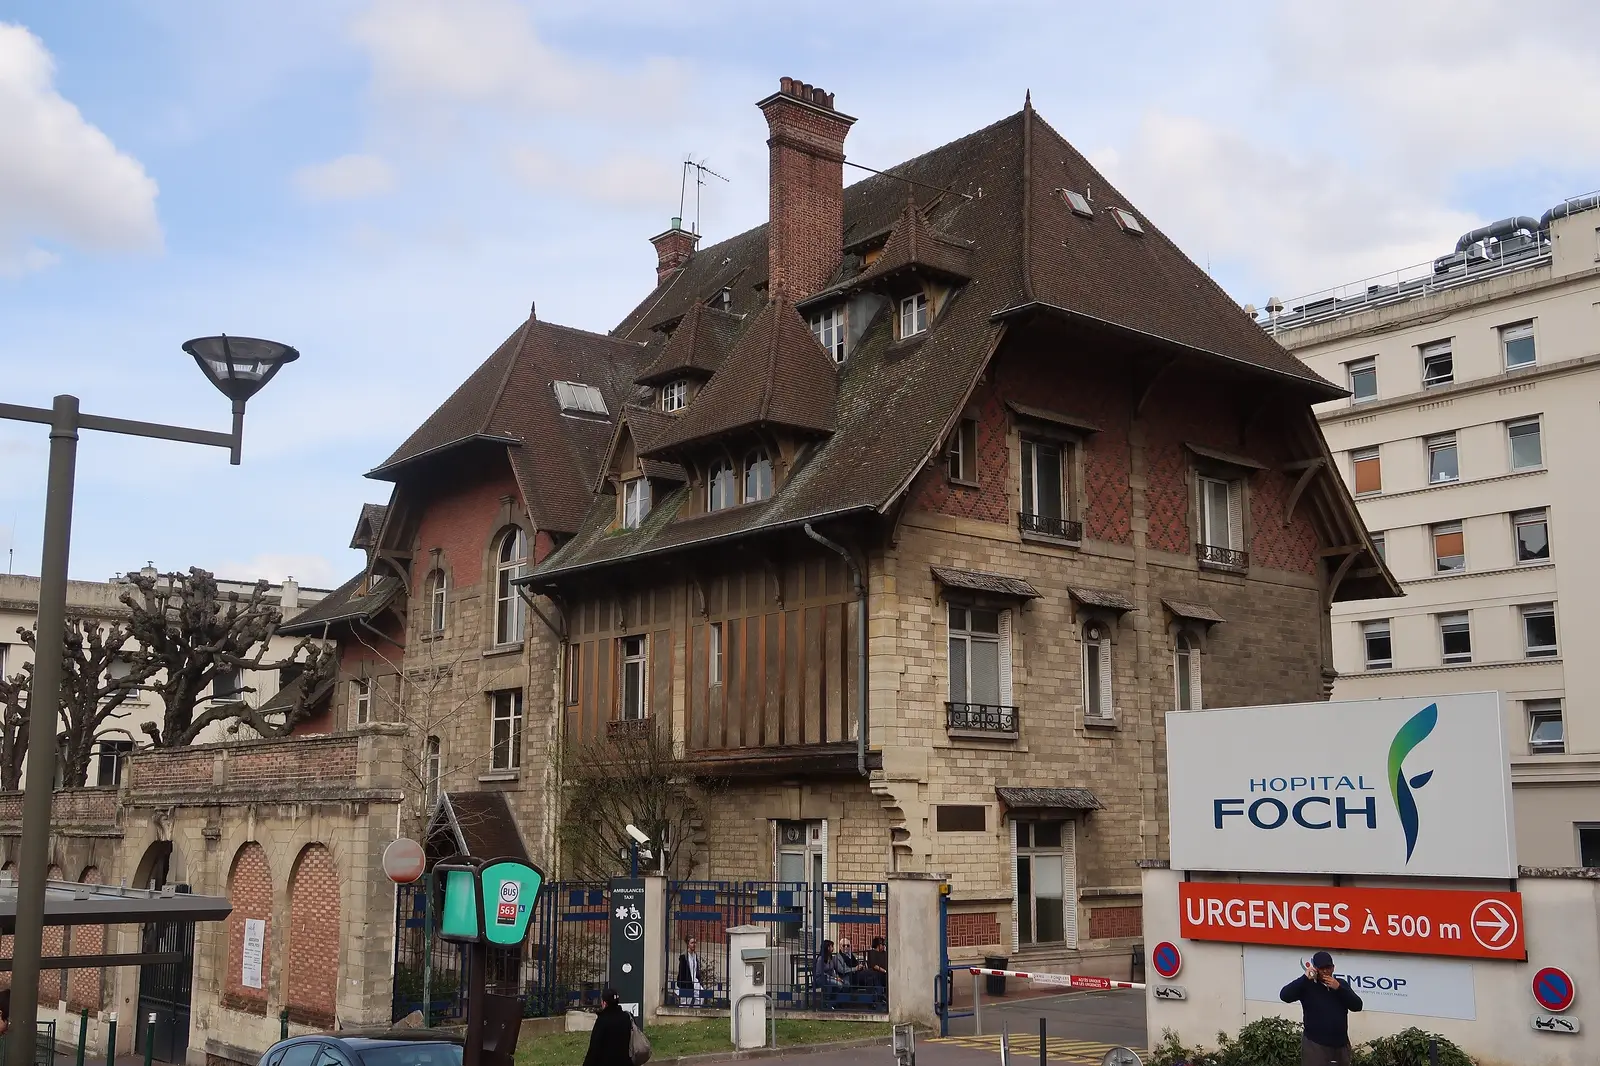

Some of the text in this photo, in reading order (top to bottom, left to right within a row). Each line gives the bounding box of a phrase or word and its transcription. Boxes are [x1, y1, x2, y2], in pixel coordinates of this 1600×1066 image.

[1250, 776, 1375, 792] HOPITAL
[1213, 797, 1377, 829] FOCH
[503, 888, 516, 896] BUS
[500, 905, 515, 915] 563
[1186, 898, 1461, 939] URGENCES À 500 m
